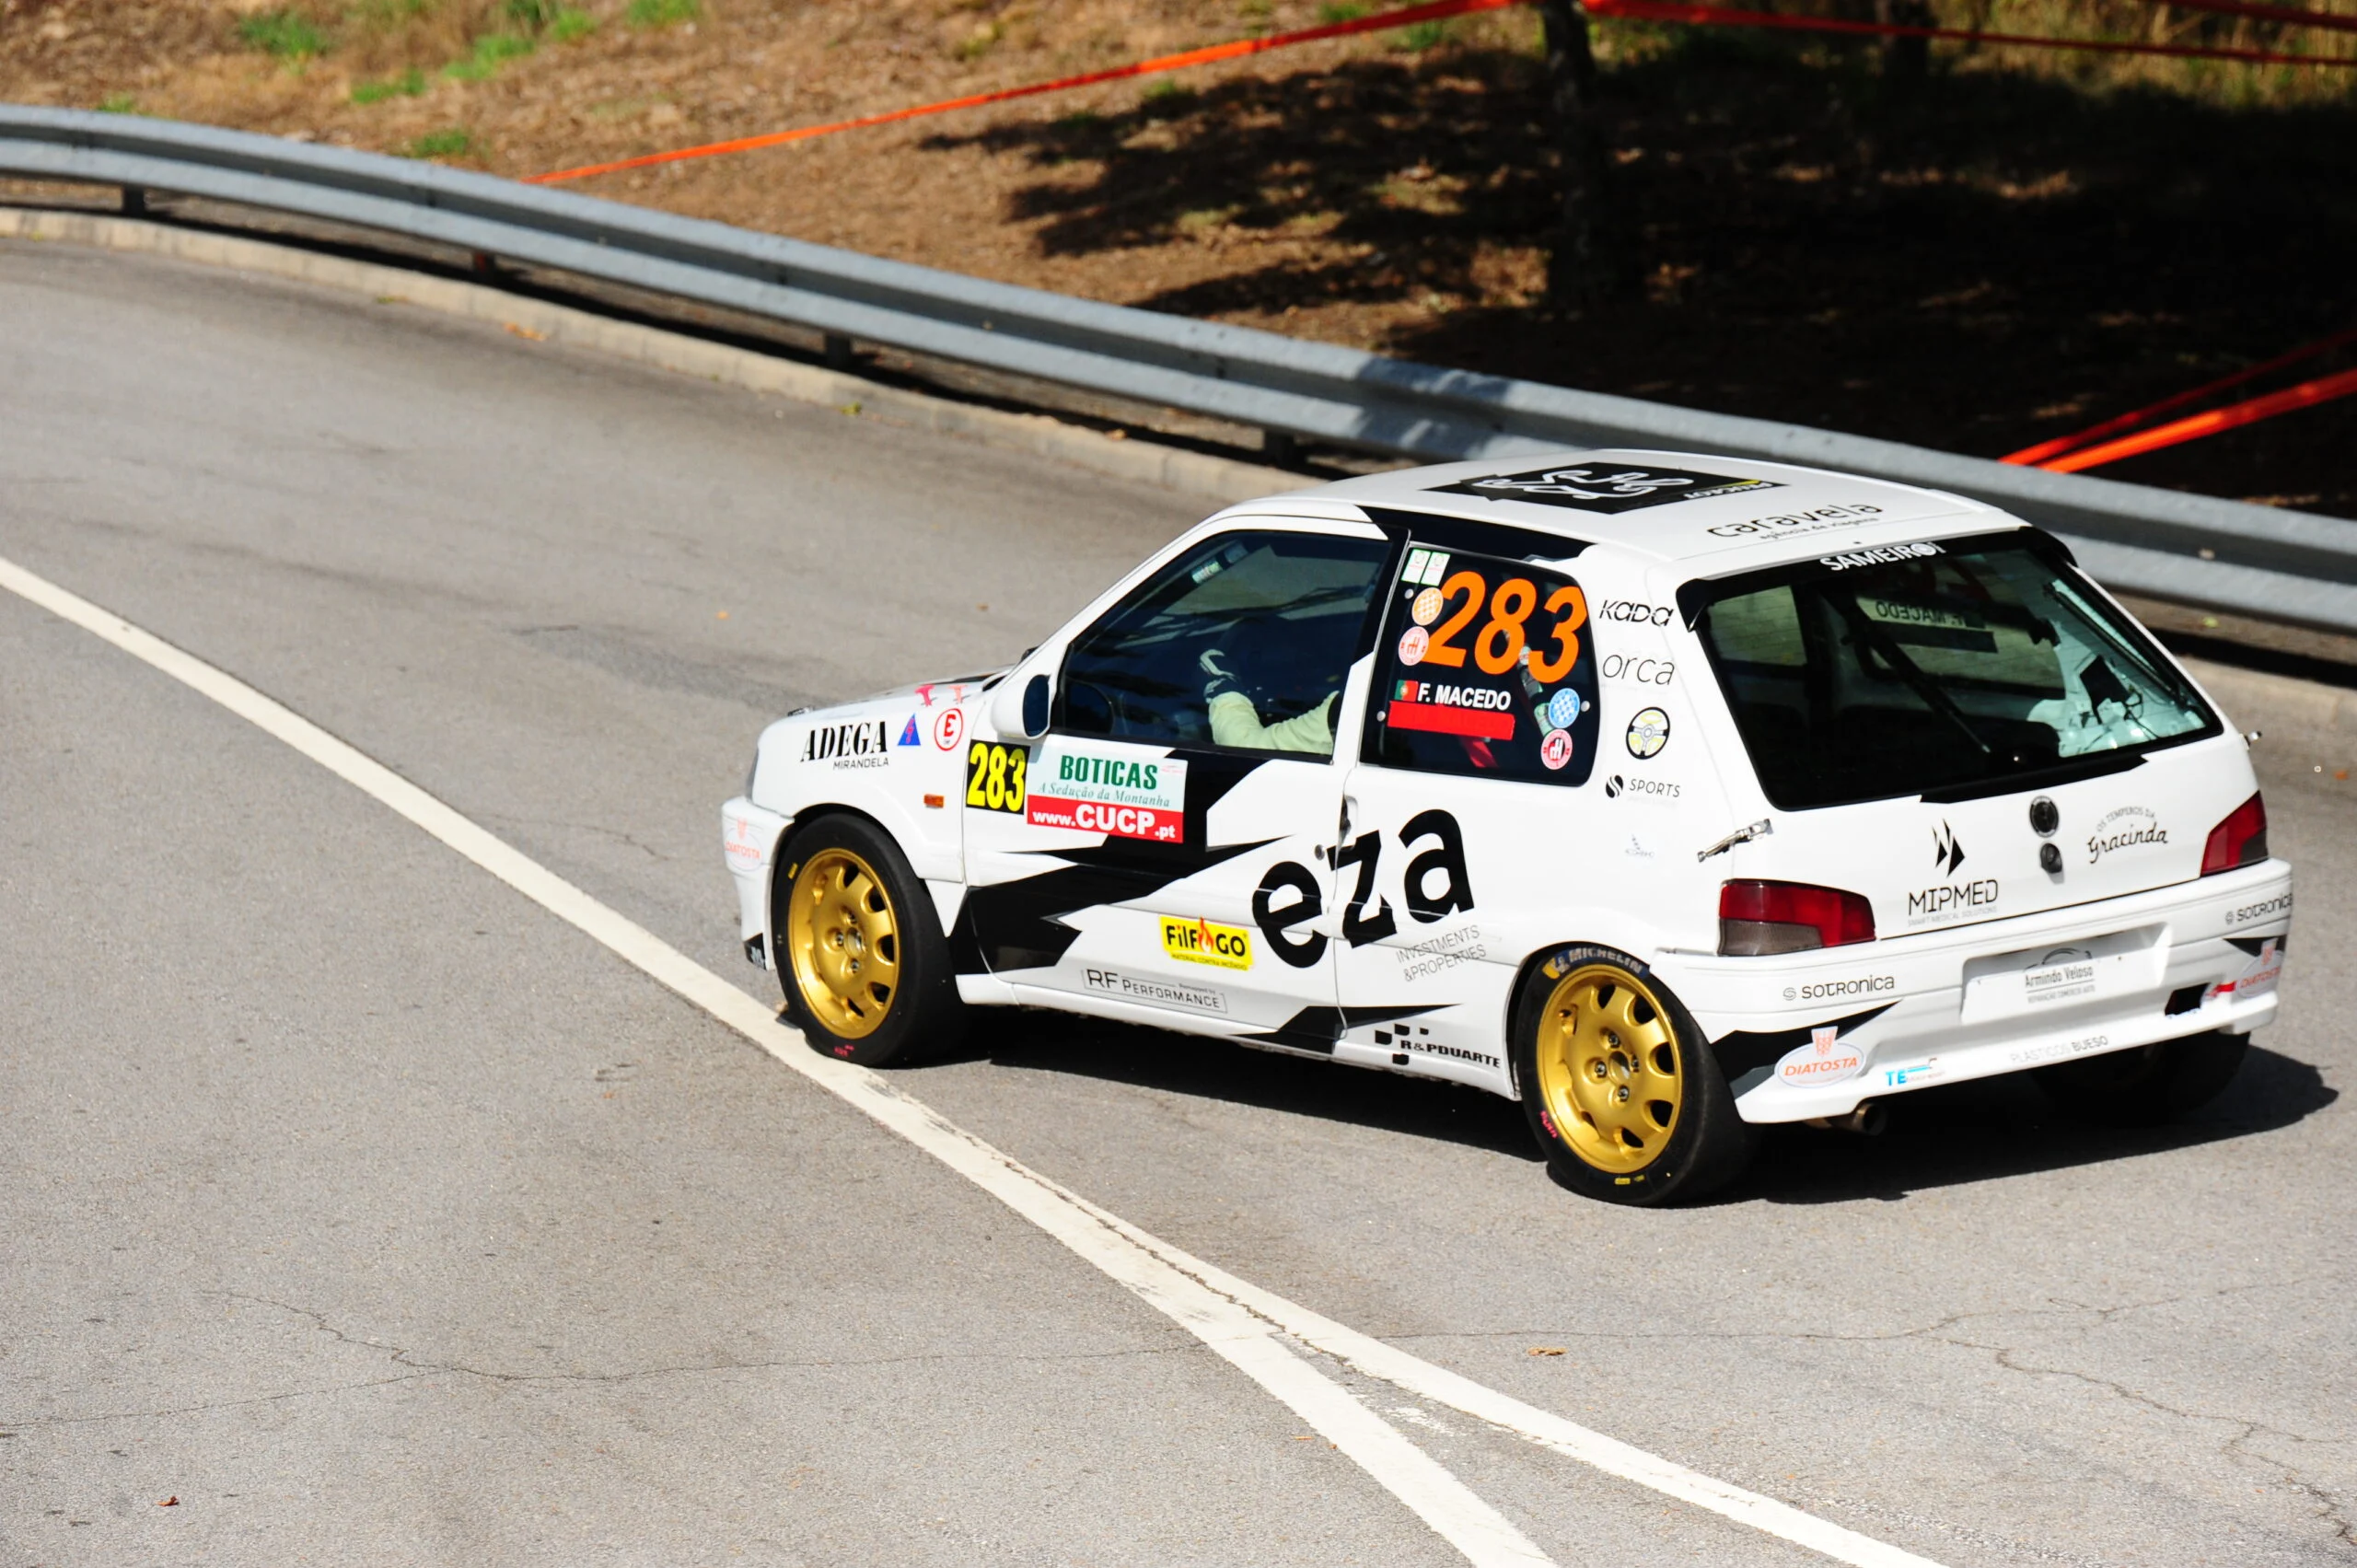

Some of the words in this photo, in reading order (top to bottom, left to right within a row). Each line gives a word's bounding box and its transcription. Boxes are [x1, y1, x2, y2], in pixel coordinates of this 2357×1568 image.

[1707, 504, 1883, 538] caravela
[1420, 570, 1588, 684] 283
[1602, 654, 1676, 686] orca
[1418, 682, 1431, 703] F.
[1434, 684, 1512, 711] MACEDO
[800, 720, 888, 763] ADEGA
[832, 757, 889, 772] MIRANDELA
[966, 742, 1027, 813] 283
[1060, 754, 1158, 790] BOTICAS
[1038, 783, 1047, 794] A
[1048, 784, 1095, 800] Sedução
[1097, 788, 1110, 800] da
[1115, 790, 1171, 807] Montanha
[1629, 778, 1681, 798] SPORTS
[1032, 804, 1176, 841] www.CUCP.pt
[2086, 820, 2169, 865] Gracinda
[1252, 808, 1475, 969] eza
[1908, 878, 1999, 916] MIPMED
[1395, 924, 1480, 964] INVESTMENTS
[1568, 947, 1643, 974] MICHELIN
[1403, 943, 1488, 983] &PROPERTIES
[1086, 968, 1118, 990] RF
[1121, 978, 1221, 1009] PERFORMANCE
[1783, 1056, 1858, 1076] DIATOSTA
